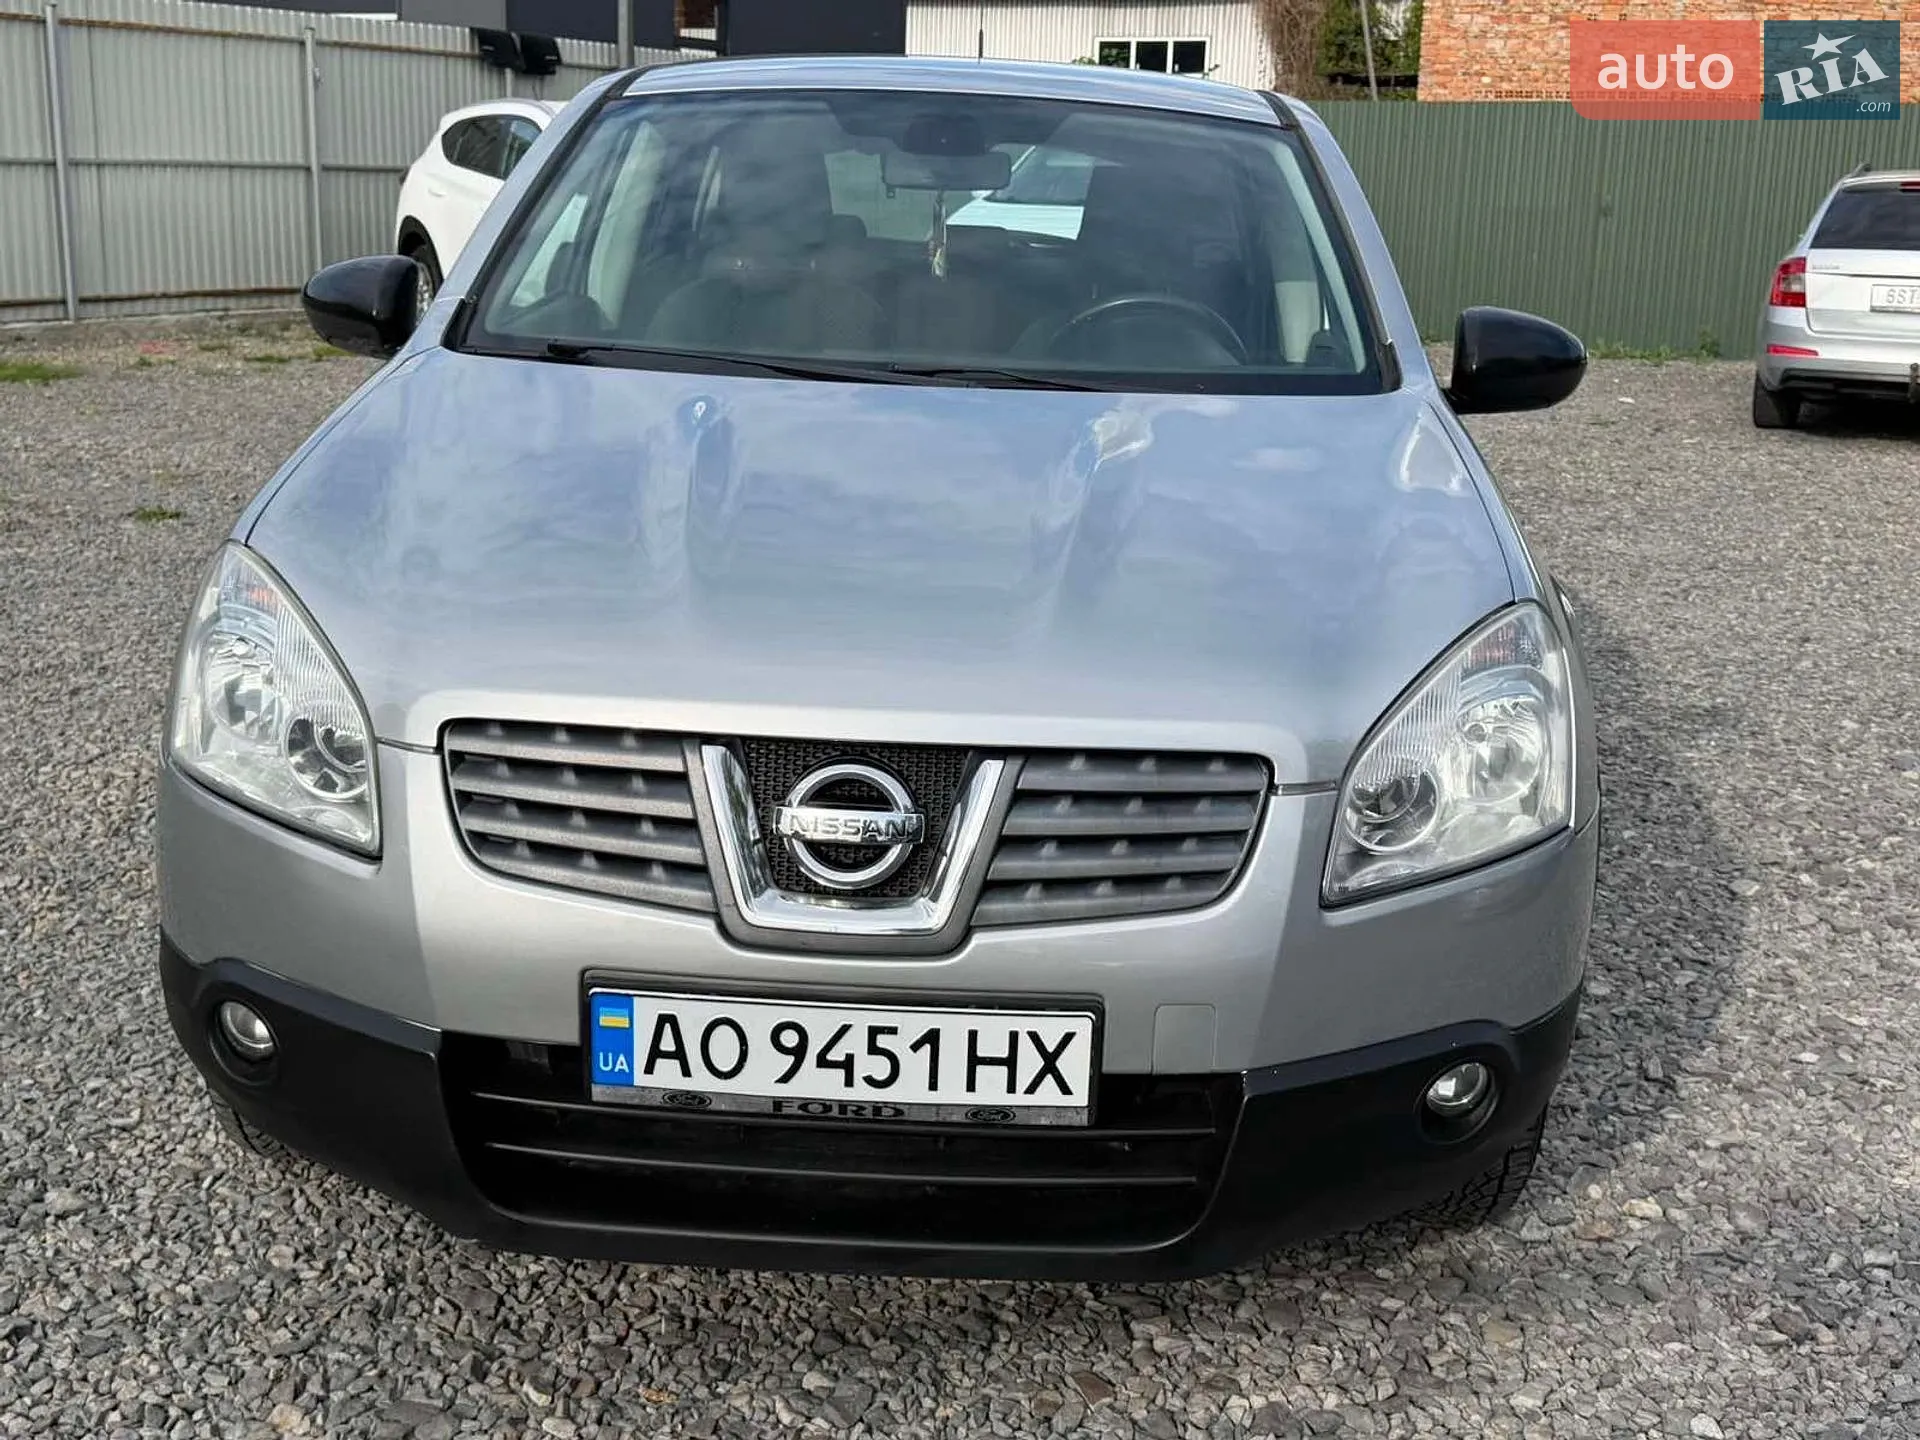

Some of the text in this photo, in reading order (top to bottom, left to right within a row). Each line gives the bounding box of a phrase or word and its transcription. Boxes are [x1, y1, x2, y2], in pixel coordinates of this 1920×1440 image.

[789, 814, 909, 841] NISSAN
[599, 1052, 629, 1074] UA
[643, 1012, 1078, 1096] AO 9451 HX
[772, 1099, 905, 1118] FORD
